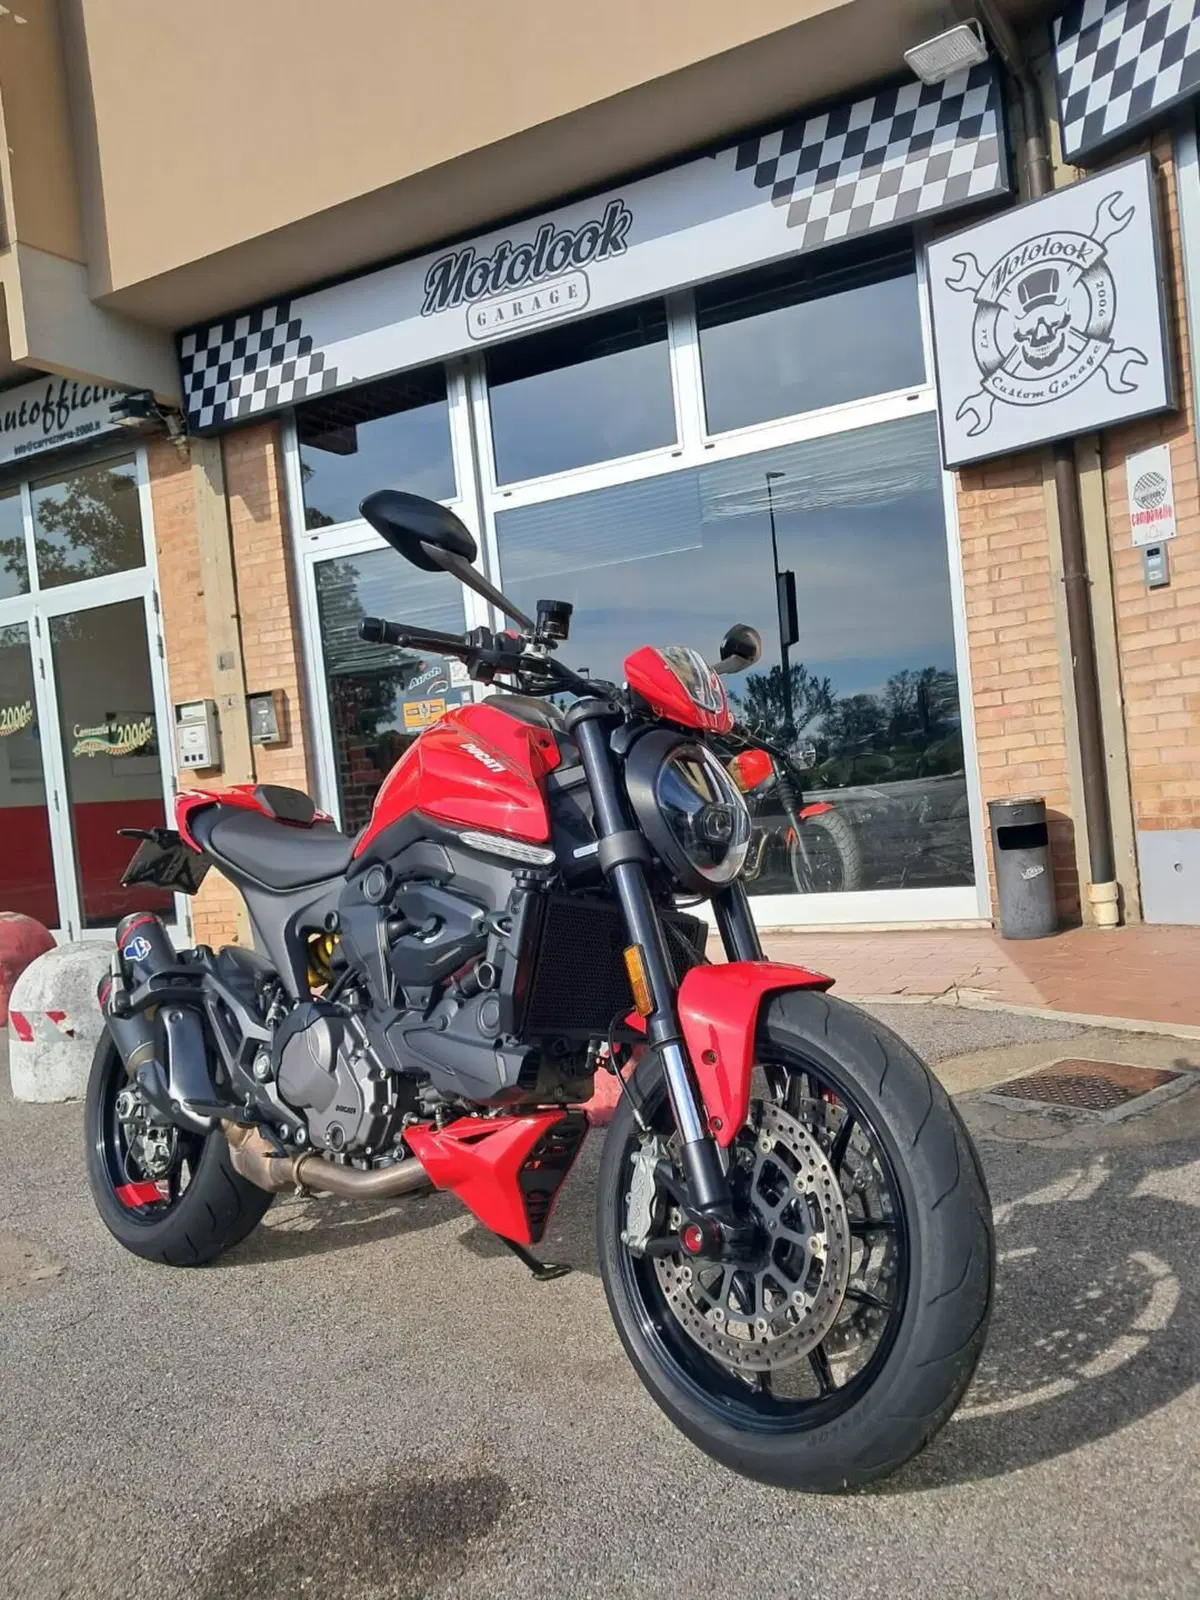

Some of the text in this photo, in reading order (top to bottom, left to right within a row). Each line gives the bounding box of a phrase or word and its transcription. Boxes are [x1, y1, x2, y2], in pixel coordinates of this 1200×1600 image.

[421, 198, 633, 317] Motolook
[991, 236, 1094, 297] Motolook
[477, 283, 578, 327] GARAGE
[1094, 280, 1107, 317] 2006
[991, 343, 1102, 399] Custom Garage
[460, 743, 506, 773] DUCATI
